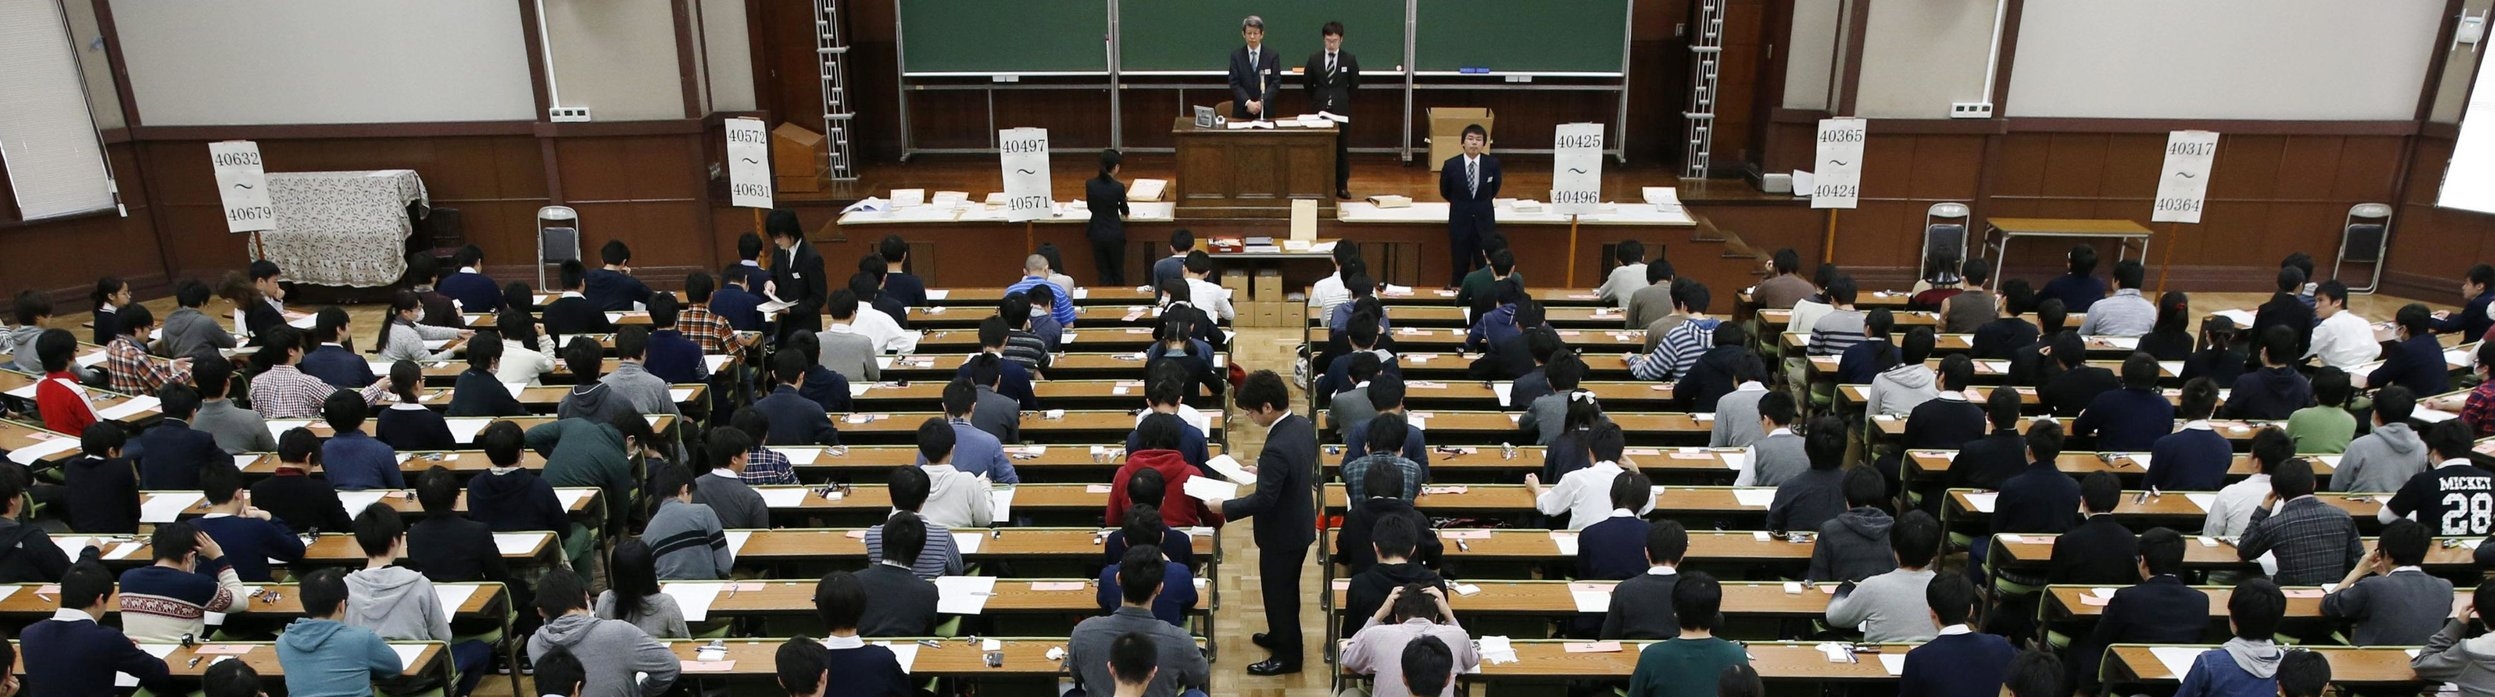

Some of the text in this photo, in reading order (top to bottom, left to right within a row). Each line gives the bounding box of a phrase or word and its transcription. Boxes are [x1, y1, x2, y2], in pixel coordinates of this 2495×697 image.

[728, 129, 766, 145] 40572
[1556, 135, 1601, 149] 40425
[1819, 129, 1863, 143] 40365
[1002, 139, 1046, 154] 40497
[2168, 142, 2214, 156] 40317
[215, 152, 260, 167] 40632
[733, 184, 770, 198] 40631
[1554, 190, 1598, 204] 40496
[1814, 184, 1856, 198] 40424
[1008, 196, 1050, 211] 40571
[2156, 198, 2201, 212] 40364
[228, 206, 272, 221] 40679
[2439, 476, 2492, 491] MICKEY
[2441, 492, 2493, 535] 28
